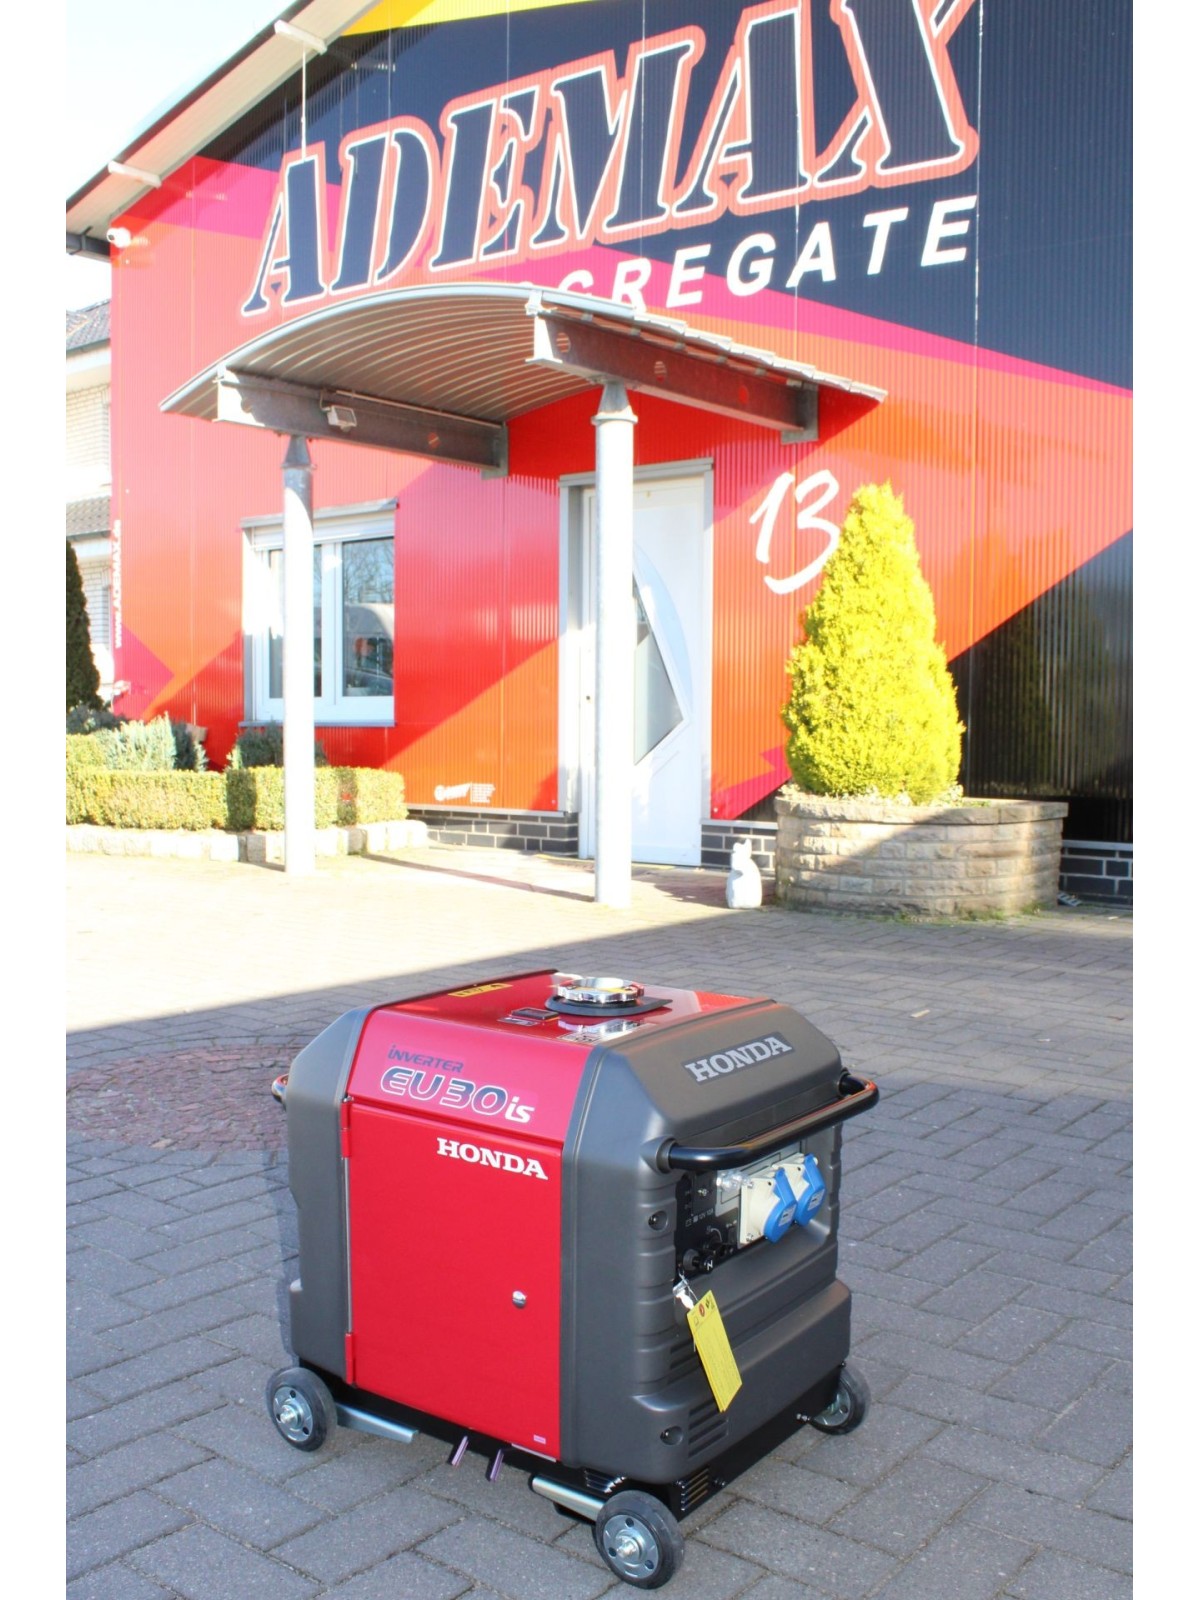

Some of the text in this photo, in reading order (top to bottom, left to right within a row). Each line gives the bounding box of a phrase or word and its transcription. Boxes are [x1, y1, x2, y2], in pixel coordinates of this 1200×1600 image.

[239, 0, 972, 317] ADEMAX
[749, 470, 840, 595] 13
[685, 1036, 793, 1082] HONDA
[436, 1137, 549, 1180] HONDA
